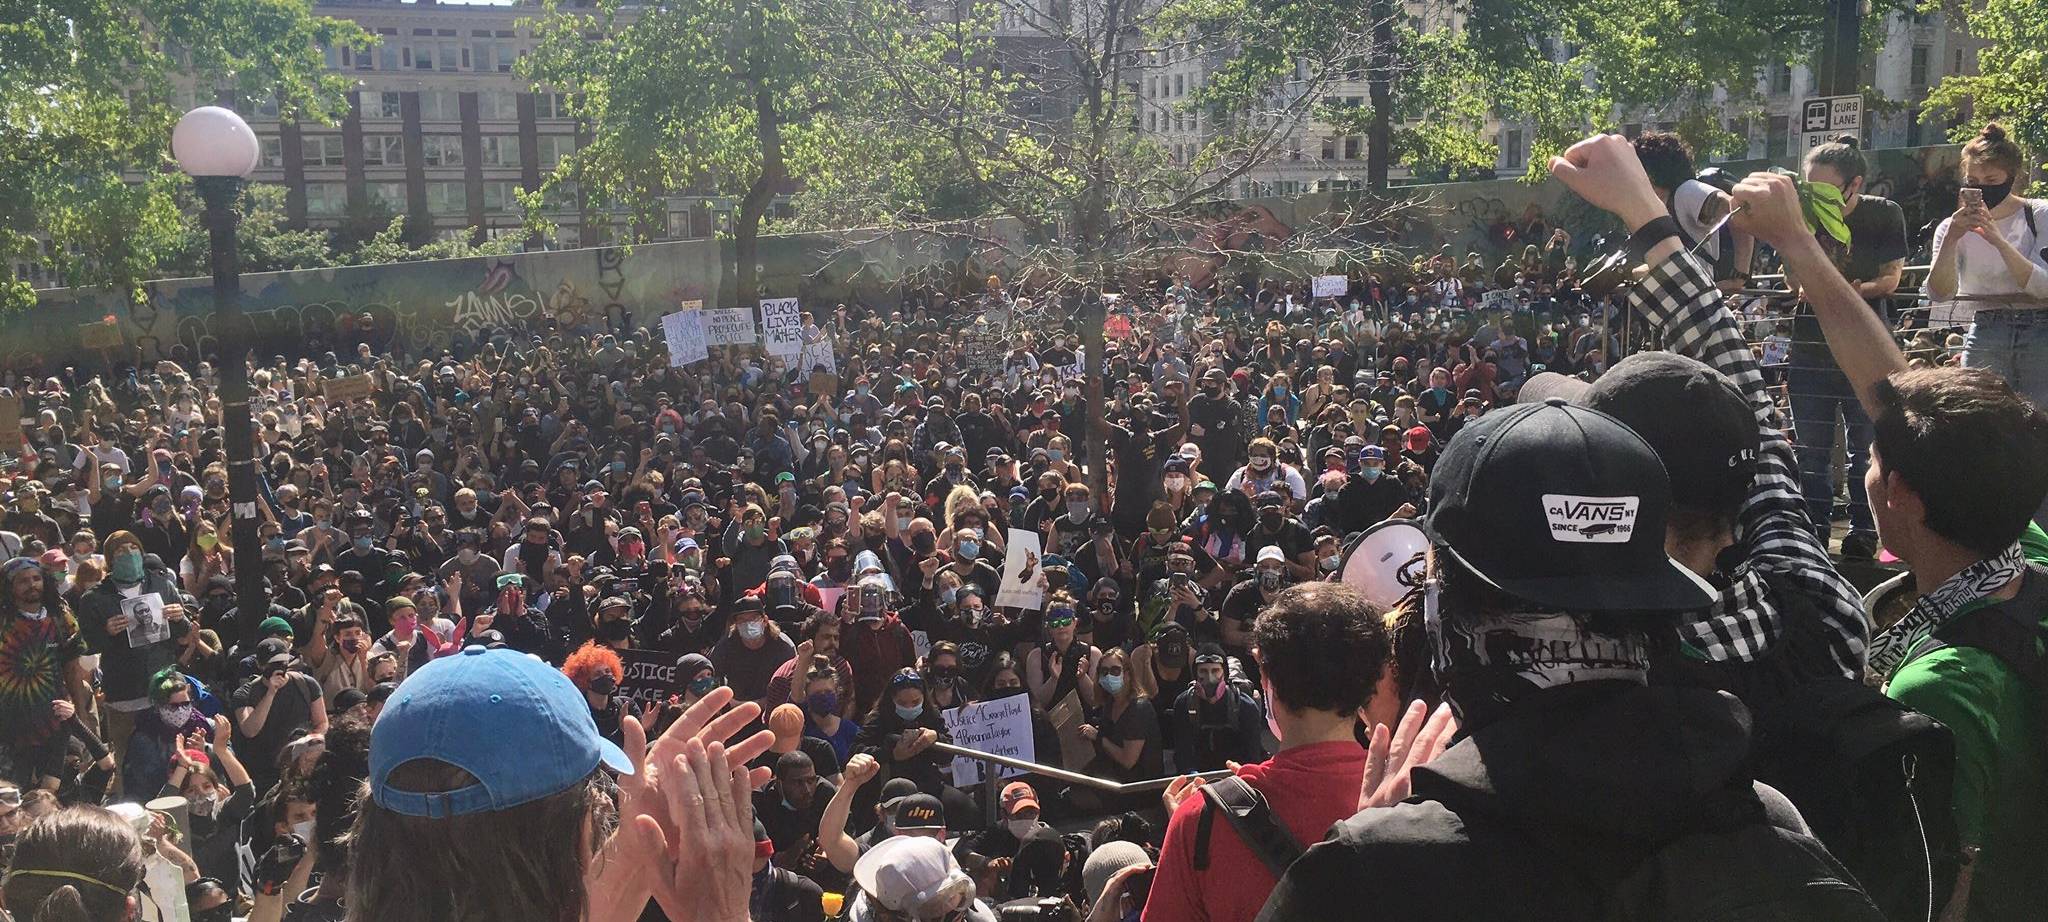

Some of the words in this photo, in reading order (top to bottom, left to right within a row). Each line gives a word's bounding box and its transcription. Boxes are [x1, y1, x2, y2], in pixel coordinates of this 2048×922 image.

[1834, 102, 1858, 113] CURB
[1833, 114, 1857, 126] LANE
[762, 301, 798, 316] BLACK
[767, 315, 799, 329] LIVES
[1550, 507, 1564, 517] CA
[1565, 501, 1626, 521] VANS
[1625, 509, 1634, 518] NY
[1552, 523, 1577, 532] SINCE
[1616, 524, 1631, 533] 1966
